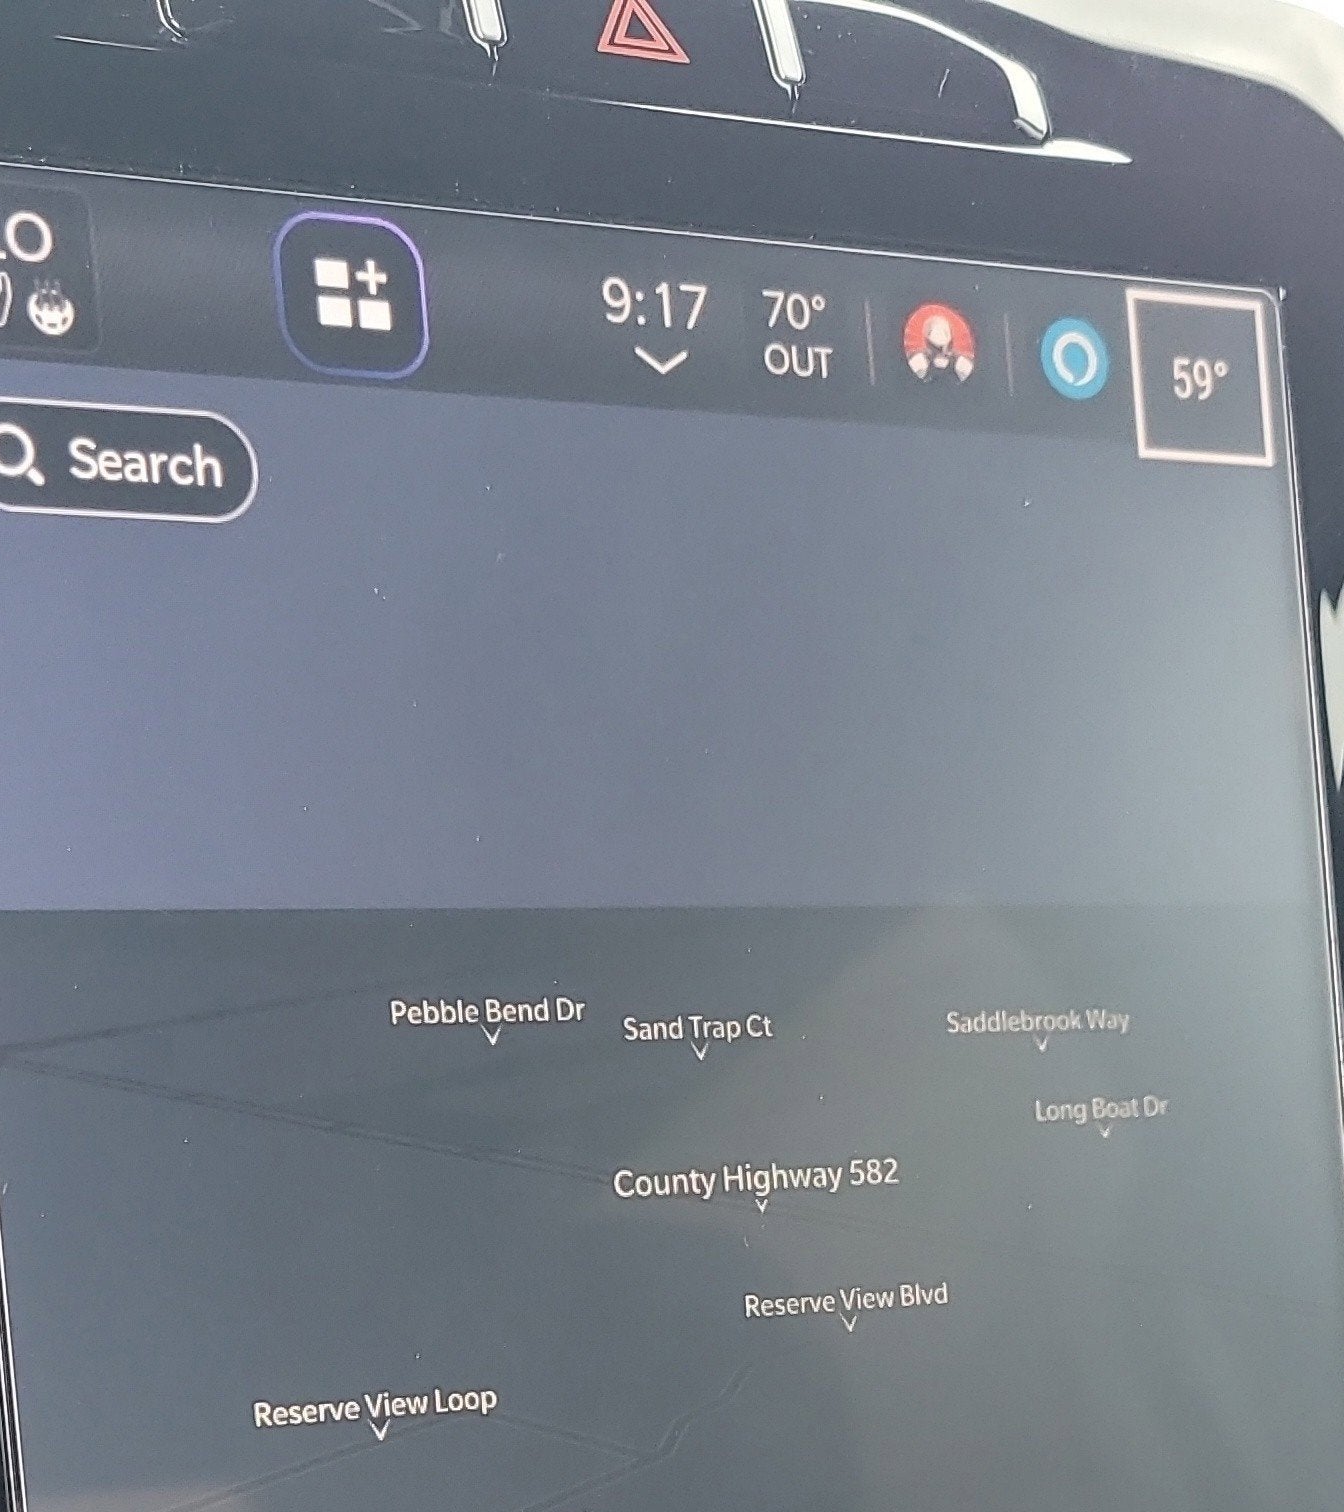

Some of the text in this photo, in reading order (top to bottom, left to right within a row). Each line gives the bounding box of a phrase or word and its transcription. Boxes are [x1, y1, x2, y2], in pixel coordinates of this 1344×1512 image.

[602, 276, 709, 331] 9:17
[760, 290, 827, 330] 70°
[762, 343, 835, 380] OUT
[69, 437, 224, 488] Search
[389, 996, 587, 1026] Pebble Bend Dr
[623, 1013, 774, 1044] Sand Trap Ct
[946, 1010, 1131, 1037] Saddlebrook Way
[1034, 1095, 1169, 1128] Long Boat Dr
[613, 1157, 900, 1201] County Highway 582
[744, 1282, 949, 1318] Reserve View Blvd
[254, 1388, 498, 1428] Reserve View Loop
